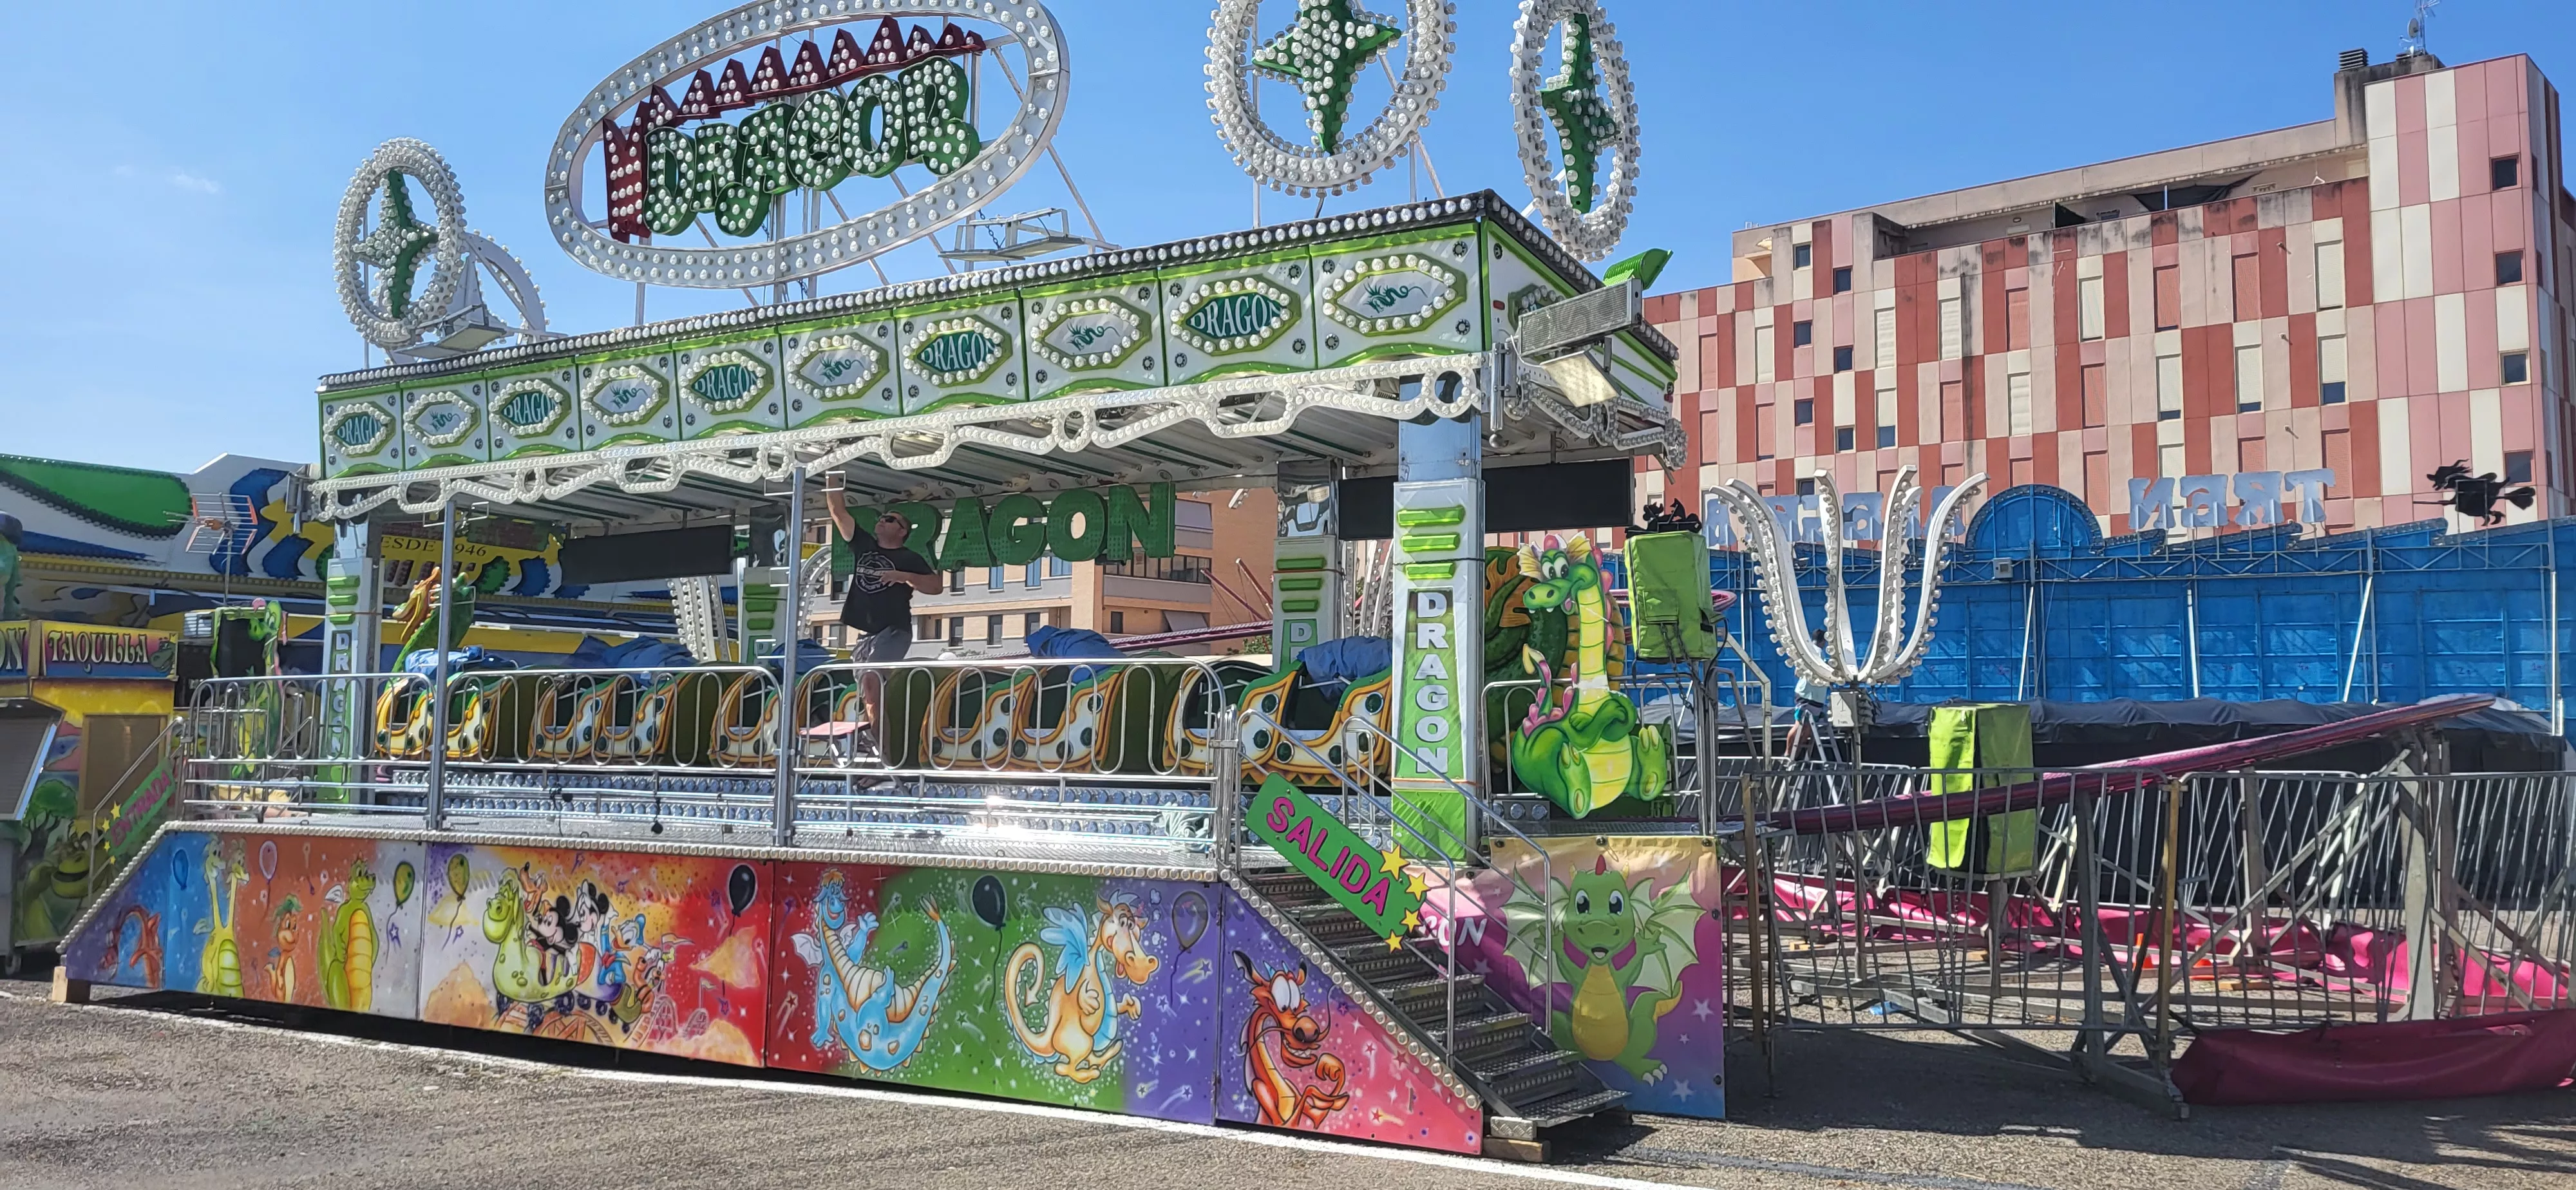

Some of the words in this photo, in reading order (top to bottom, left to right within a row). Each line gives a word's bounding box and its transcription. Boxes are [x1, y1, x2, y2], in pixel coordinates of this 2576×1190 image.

[48, 629, 149, 674] TAQUILLA
[1413, 592, 1449, 773] DRAGON
[111, 771, 171, 847] ENTRADA
[1266, 797, 1390, 916] SALIDA
